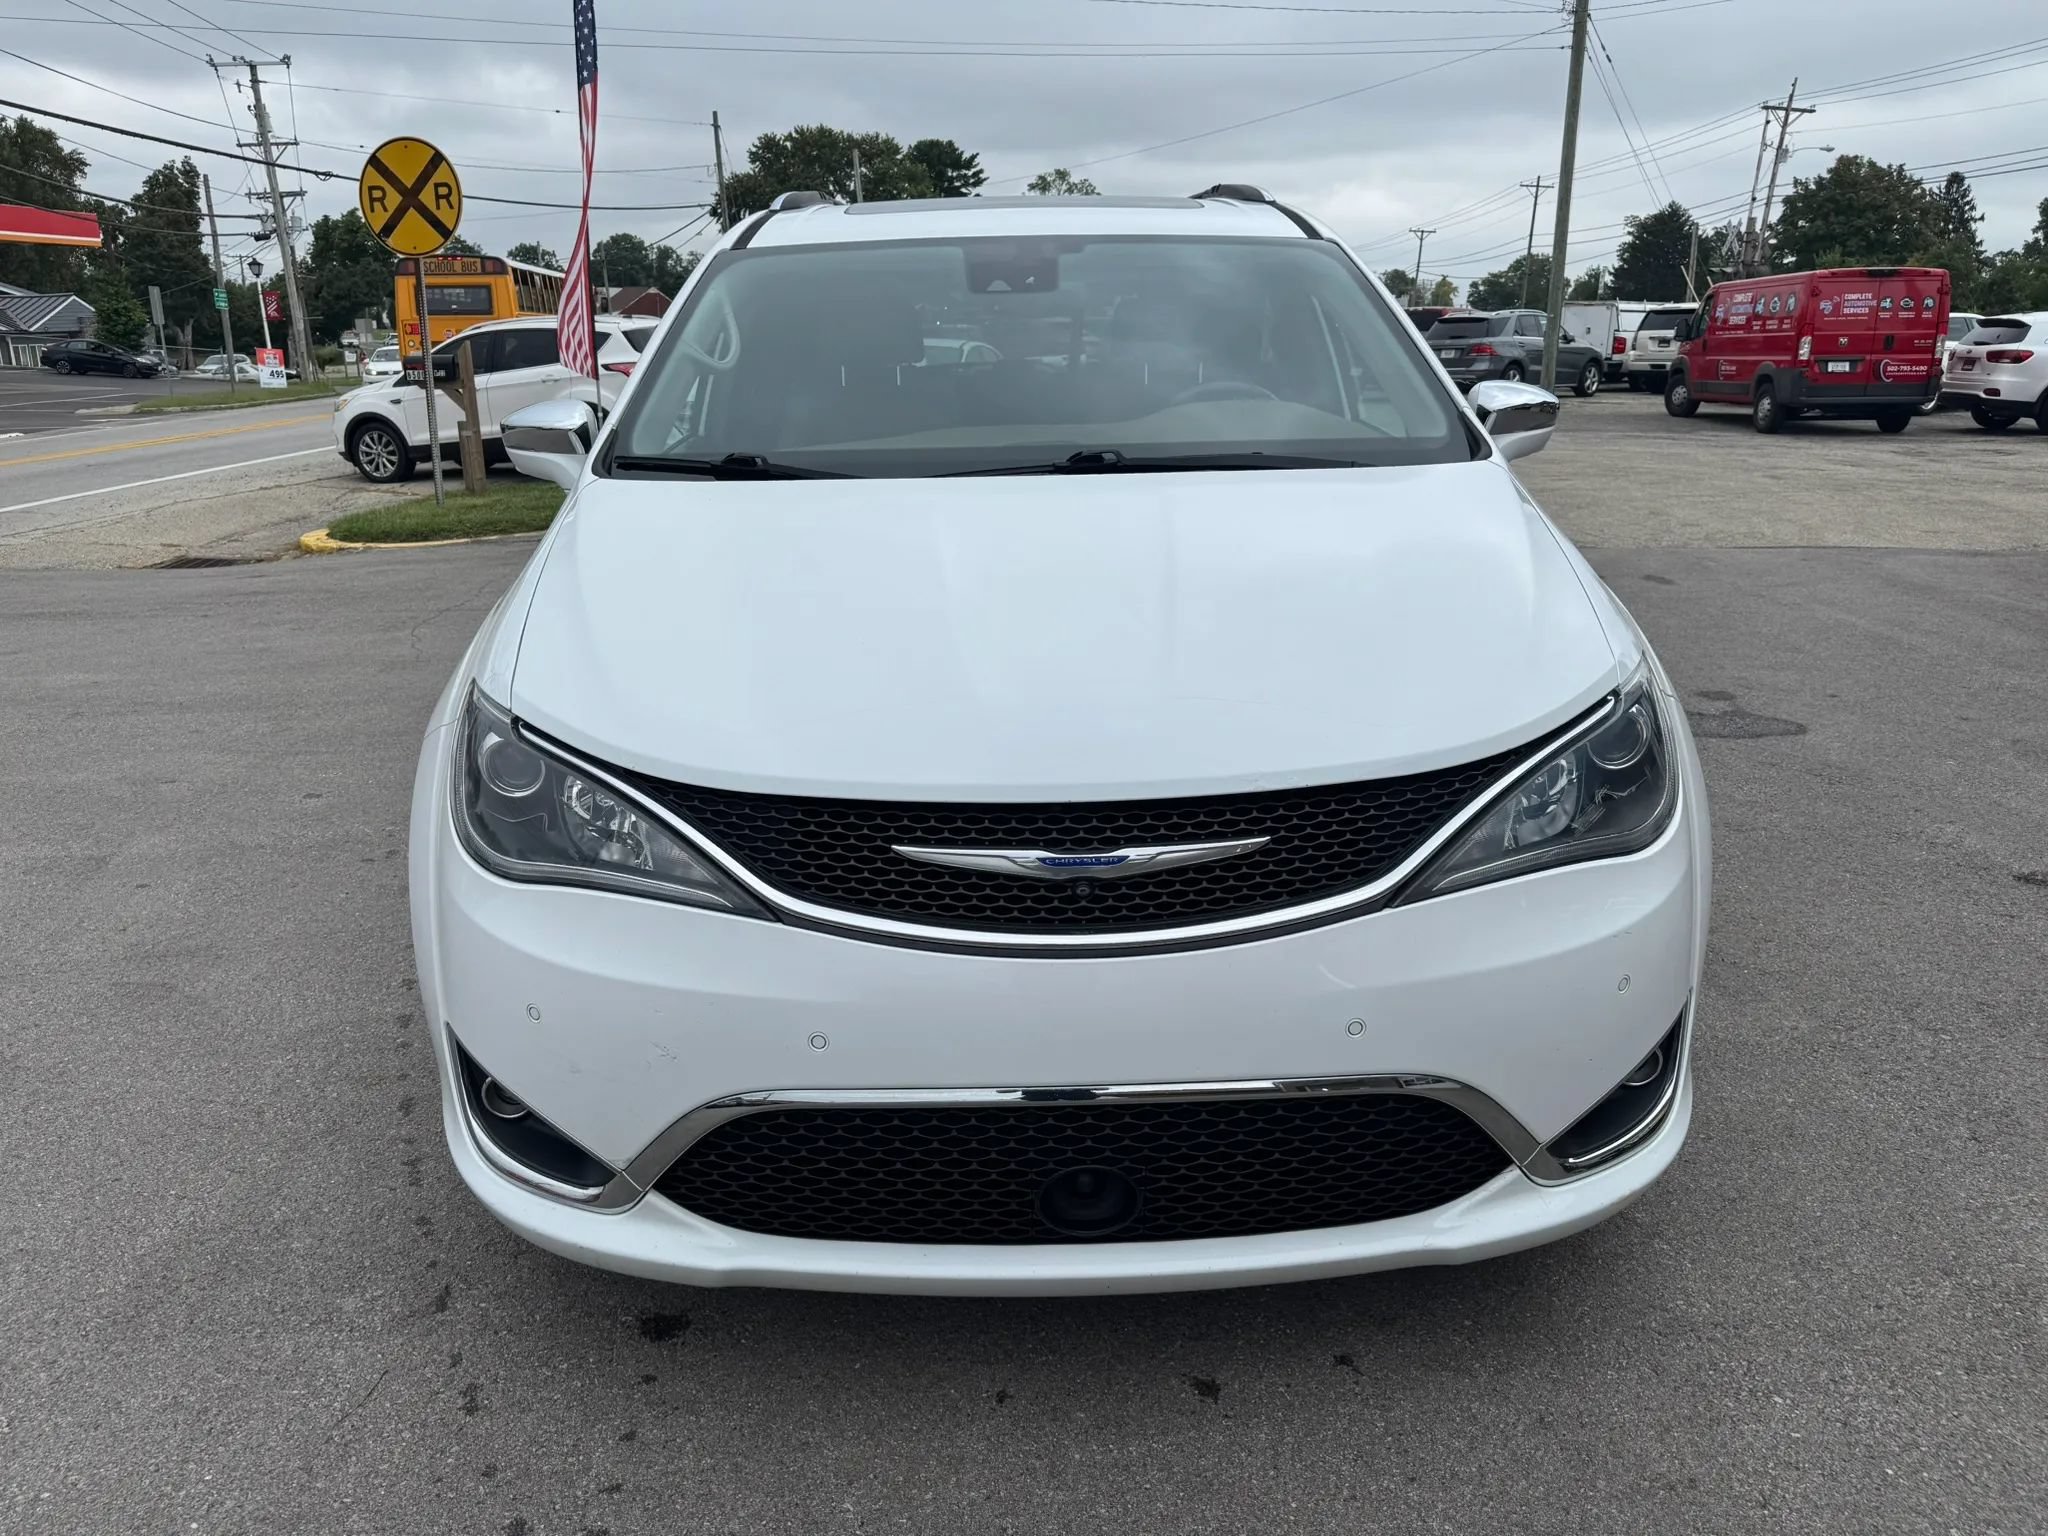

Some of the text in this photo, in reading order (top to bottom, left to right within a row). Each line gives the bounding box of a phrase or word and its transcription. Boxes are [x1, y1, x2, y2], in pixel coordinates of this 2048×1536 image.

[367, 182, 454, 213] R R
[422, 260, 478, 273] SCHOOL BUS
[1844, 292, 1873, 300] COMPLETE
[1046, 857, 1118, 865] CHRYSLER
